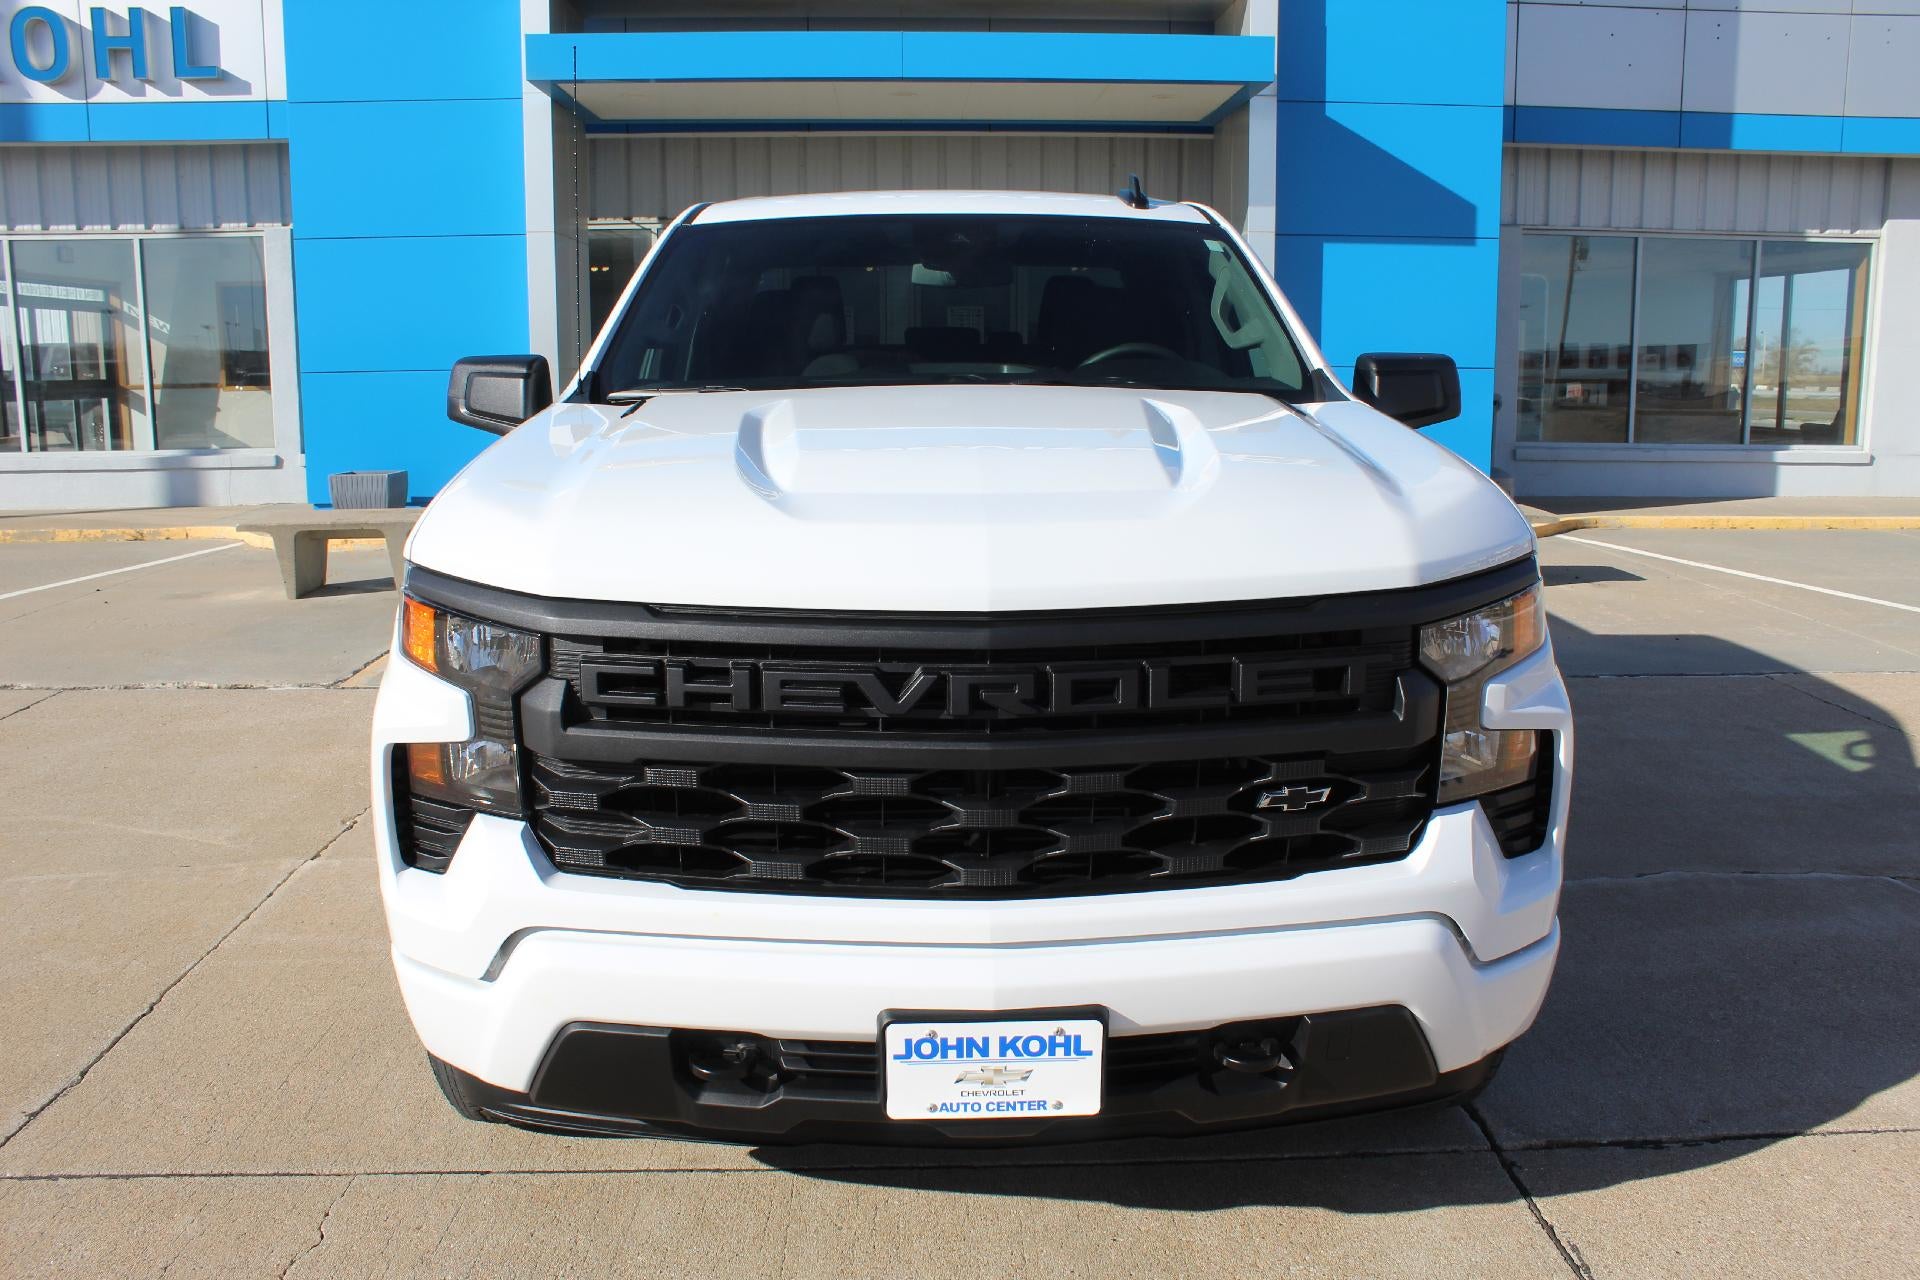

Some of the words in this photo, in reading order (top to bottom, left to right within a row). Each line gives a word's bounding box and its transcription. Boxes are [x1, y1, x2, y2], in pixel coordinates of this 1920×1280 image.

[10, 6, 221, 82] OHL
[580, 653, 1386, 718] CHEVROLET
[893, 1036, 989, 1060] JOHN
[999, 1034, 1093, 1059] KOHL
[939, 1102, 982, 1113] AUTO
[985, 1100, 1048, 1112] CENTER
[960, 1089, 1026, 1098] CHEVROLET
